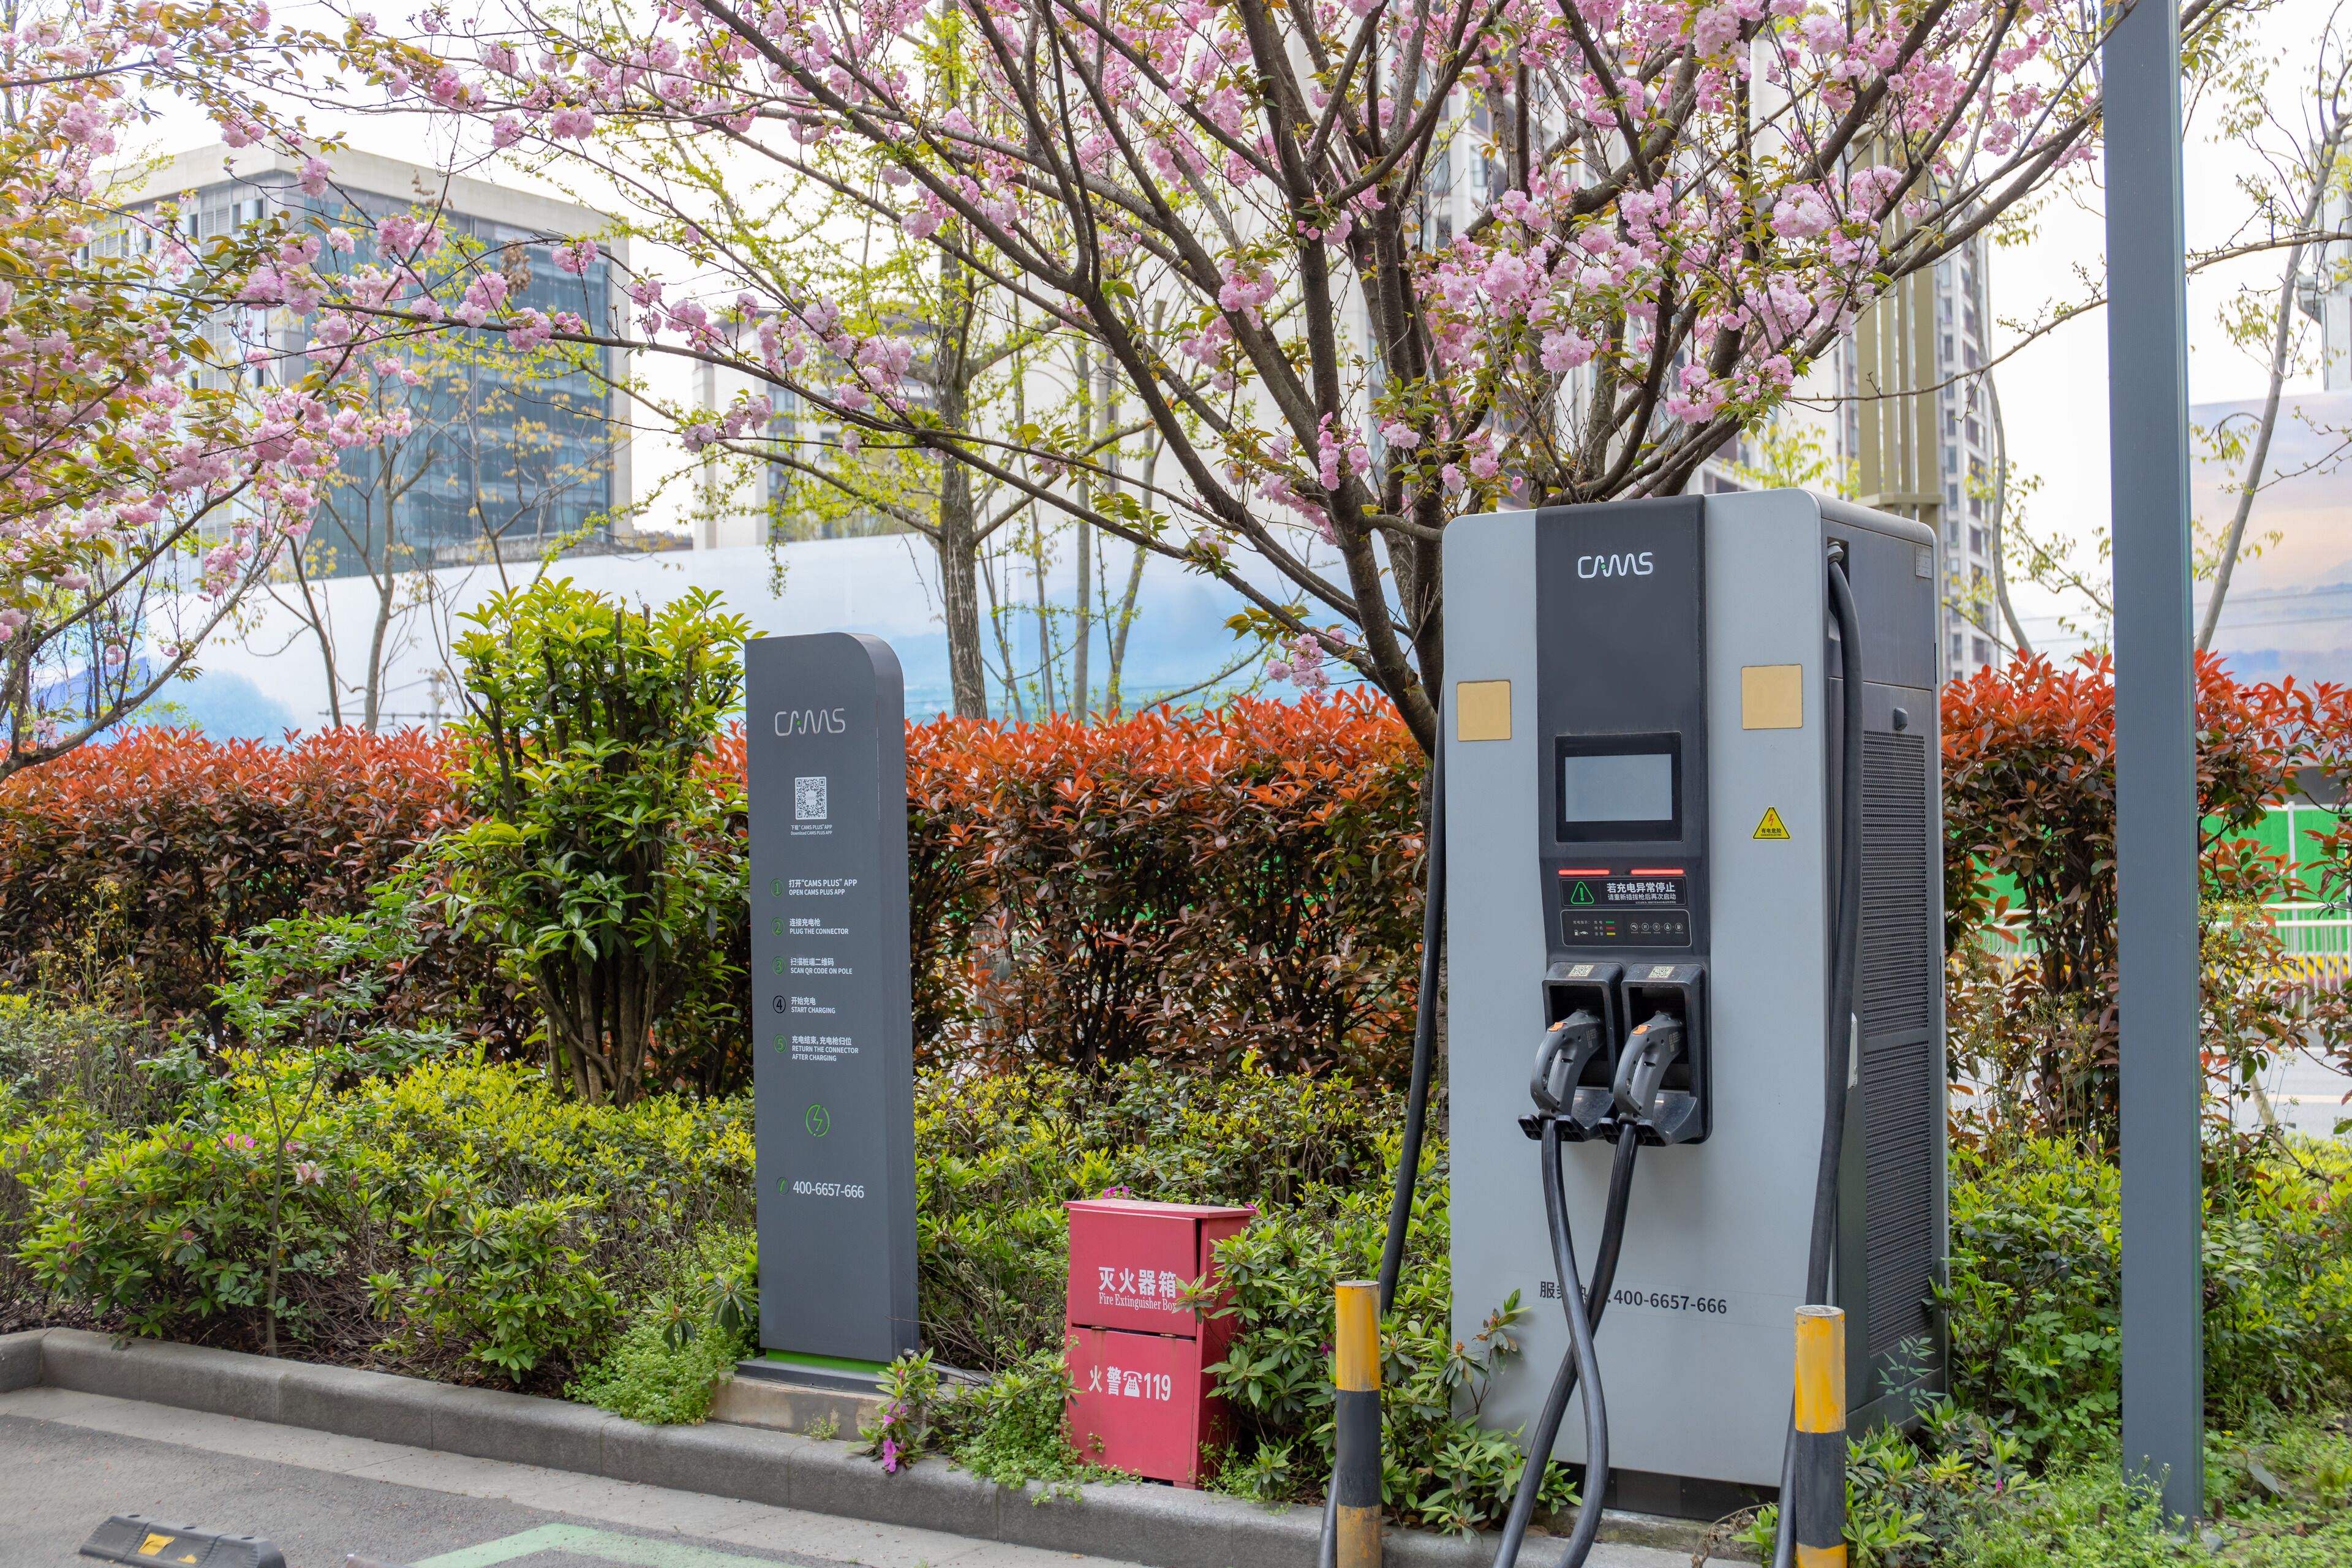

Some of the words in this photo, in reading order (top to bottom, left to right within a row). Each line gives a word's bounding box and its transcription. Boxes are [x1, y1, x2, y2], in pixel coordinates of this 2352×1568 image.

[1578, 552, 1653, 579] CAMS
[775, 707, 846, 736] CAMS
[1607, 882, 1676, 893] 若充电异常停止
[790, 918, 821, 927] 连接充电枪
[790, 957, 834, 967] 扫描桩端二维码
[791, 997, 816, 1005] 开始充电
[793, 1180, 864, 1198] 400-6657-666
[1098, 1267, 1177, 1298] 灭火器箱
[1098, 1292, 1114, 1305] Fire
[1115, 1294, 1161, 1311] Extinguisher
[1144, 1373, 1171, 1401] 119
